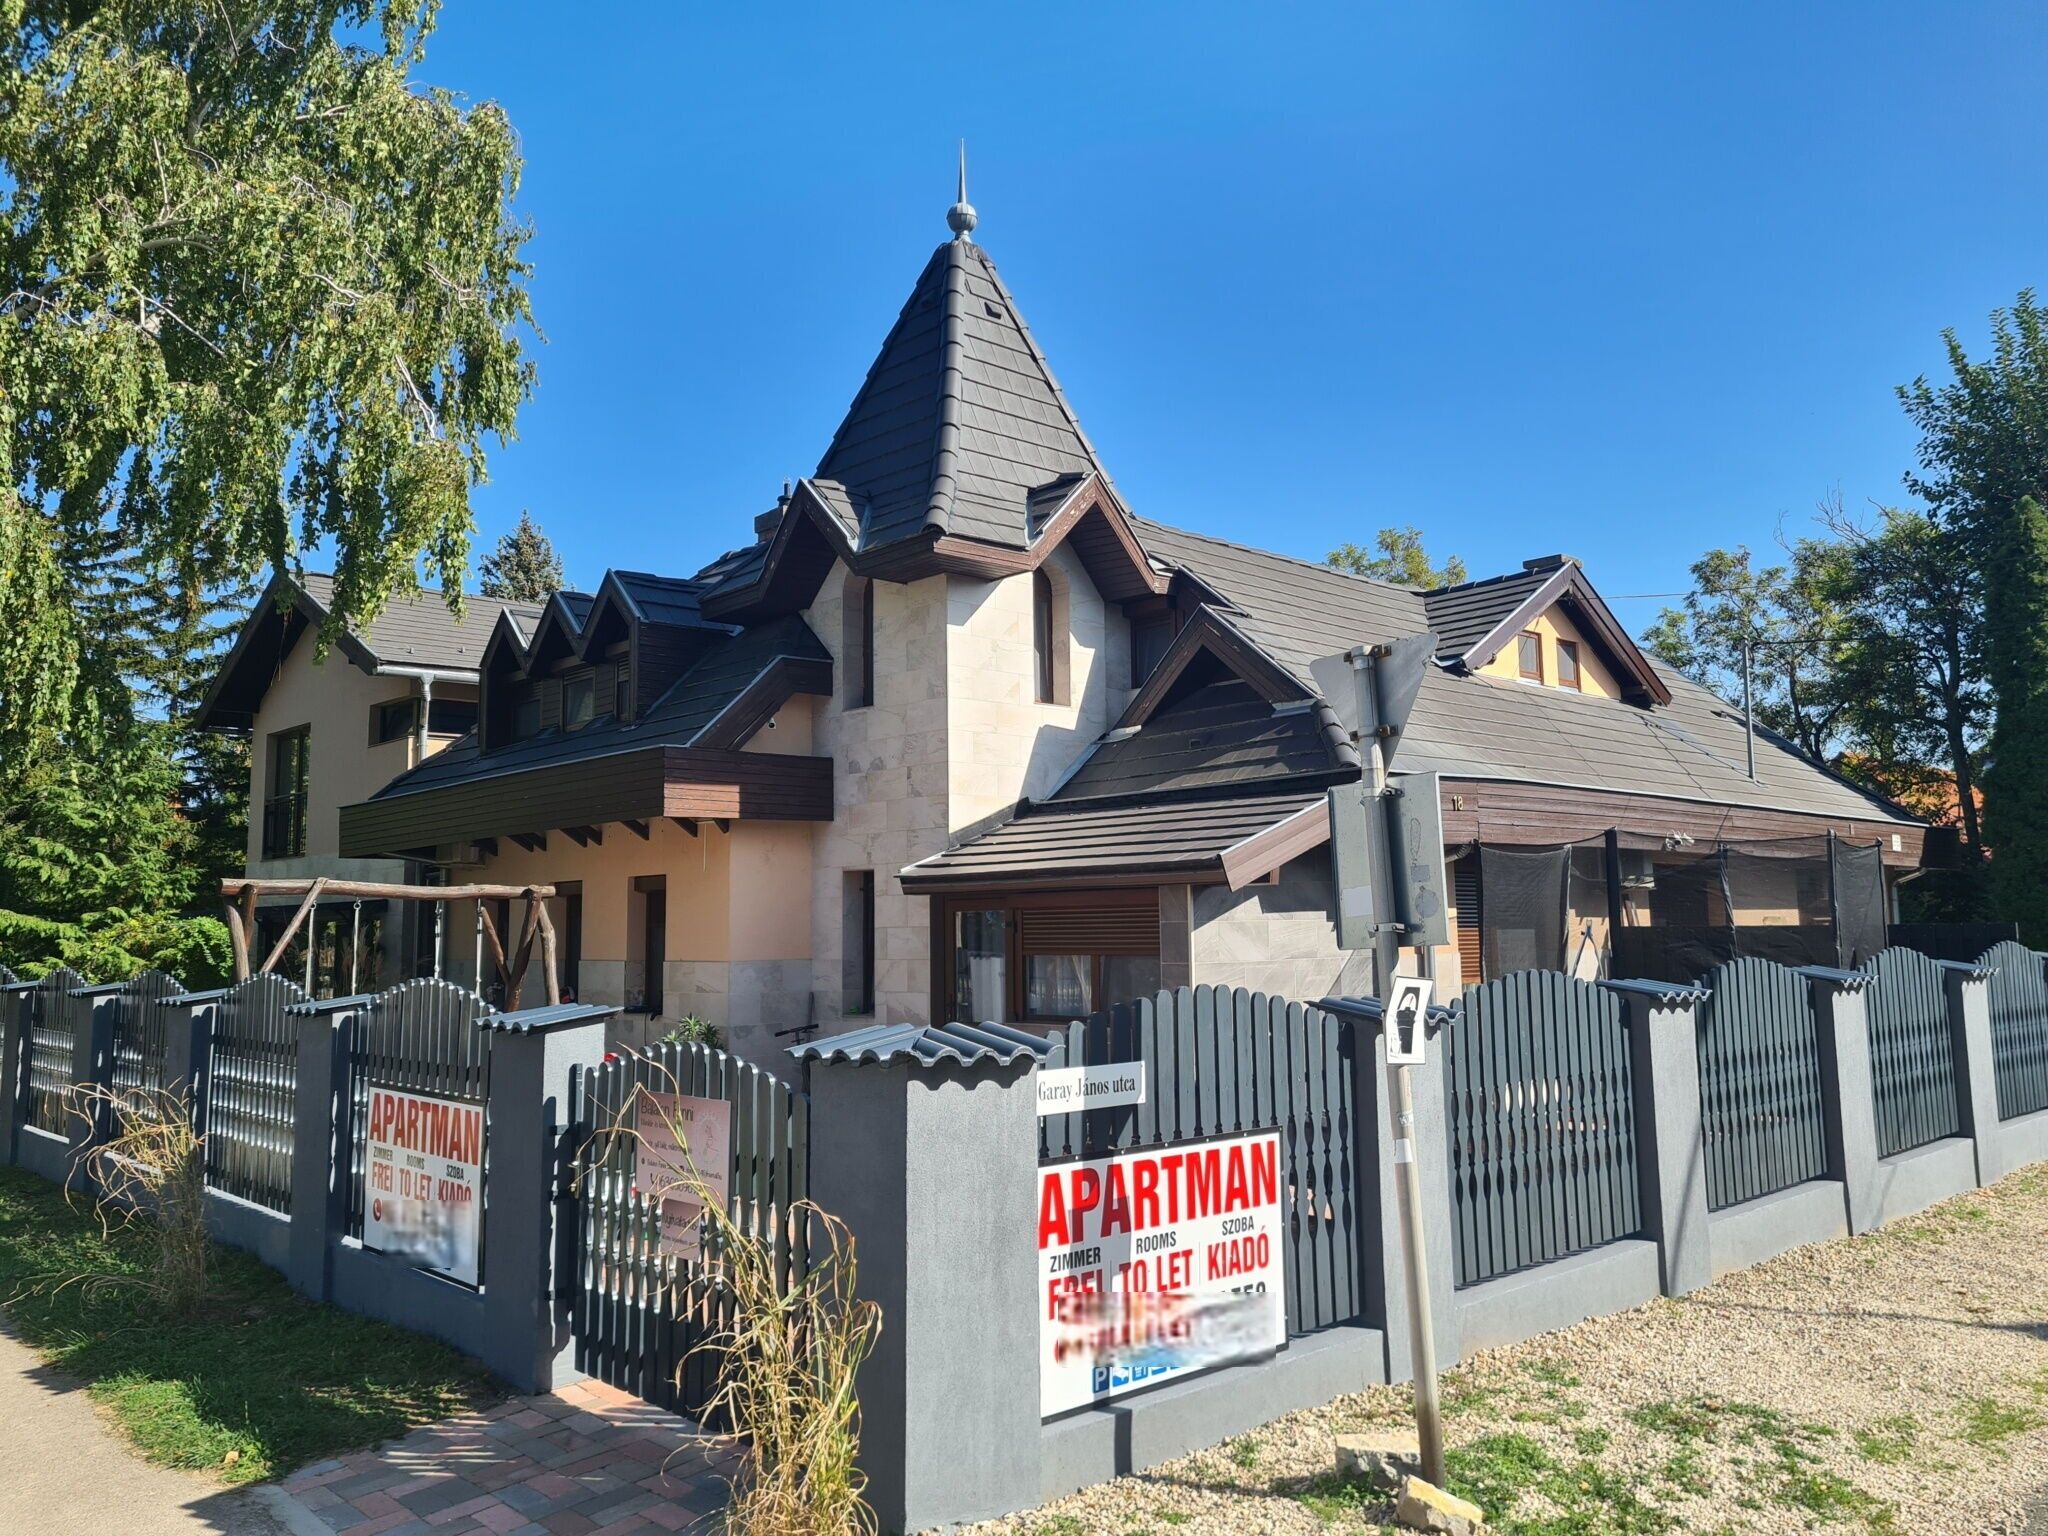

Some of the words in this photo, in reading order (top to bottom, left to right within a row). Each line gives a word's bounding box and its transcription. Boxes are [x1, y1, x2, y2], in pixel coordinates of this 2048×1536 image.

[1453, 795, 1464, 811] 18
[1038, 1081, 1072, 1103] Garay
[1075, 1075, 1110, 1098] János
[1112, 1077, 1136, 1094] utca
[369, 1092, 481, 1166] APARTMAN
[371, 1161, 393, 1193] FREI
[399, 1168, 413, 1198] TO
[414, 1172, 432, 1201] LET
[373, 1146, 394, 1162] ZIMMER
[406, 1154, 425, 1171] ROOMS
[446, 1164, 465, 1181] SZOBA
[1038, 1140, 1276, 1250] APARTMAN
[1049, 1246, 1102, 1273] ZIMMER
[1136, 1231, 1177, 1255] ROOMS
[1222, 1216, 1255, 1236] SZOBA
[1119, 1260, 1147, 1293] TO
[1156, 1249, 1193, 1292] LET
[1207, 1225, 1270, 1281] KIADÓ
